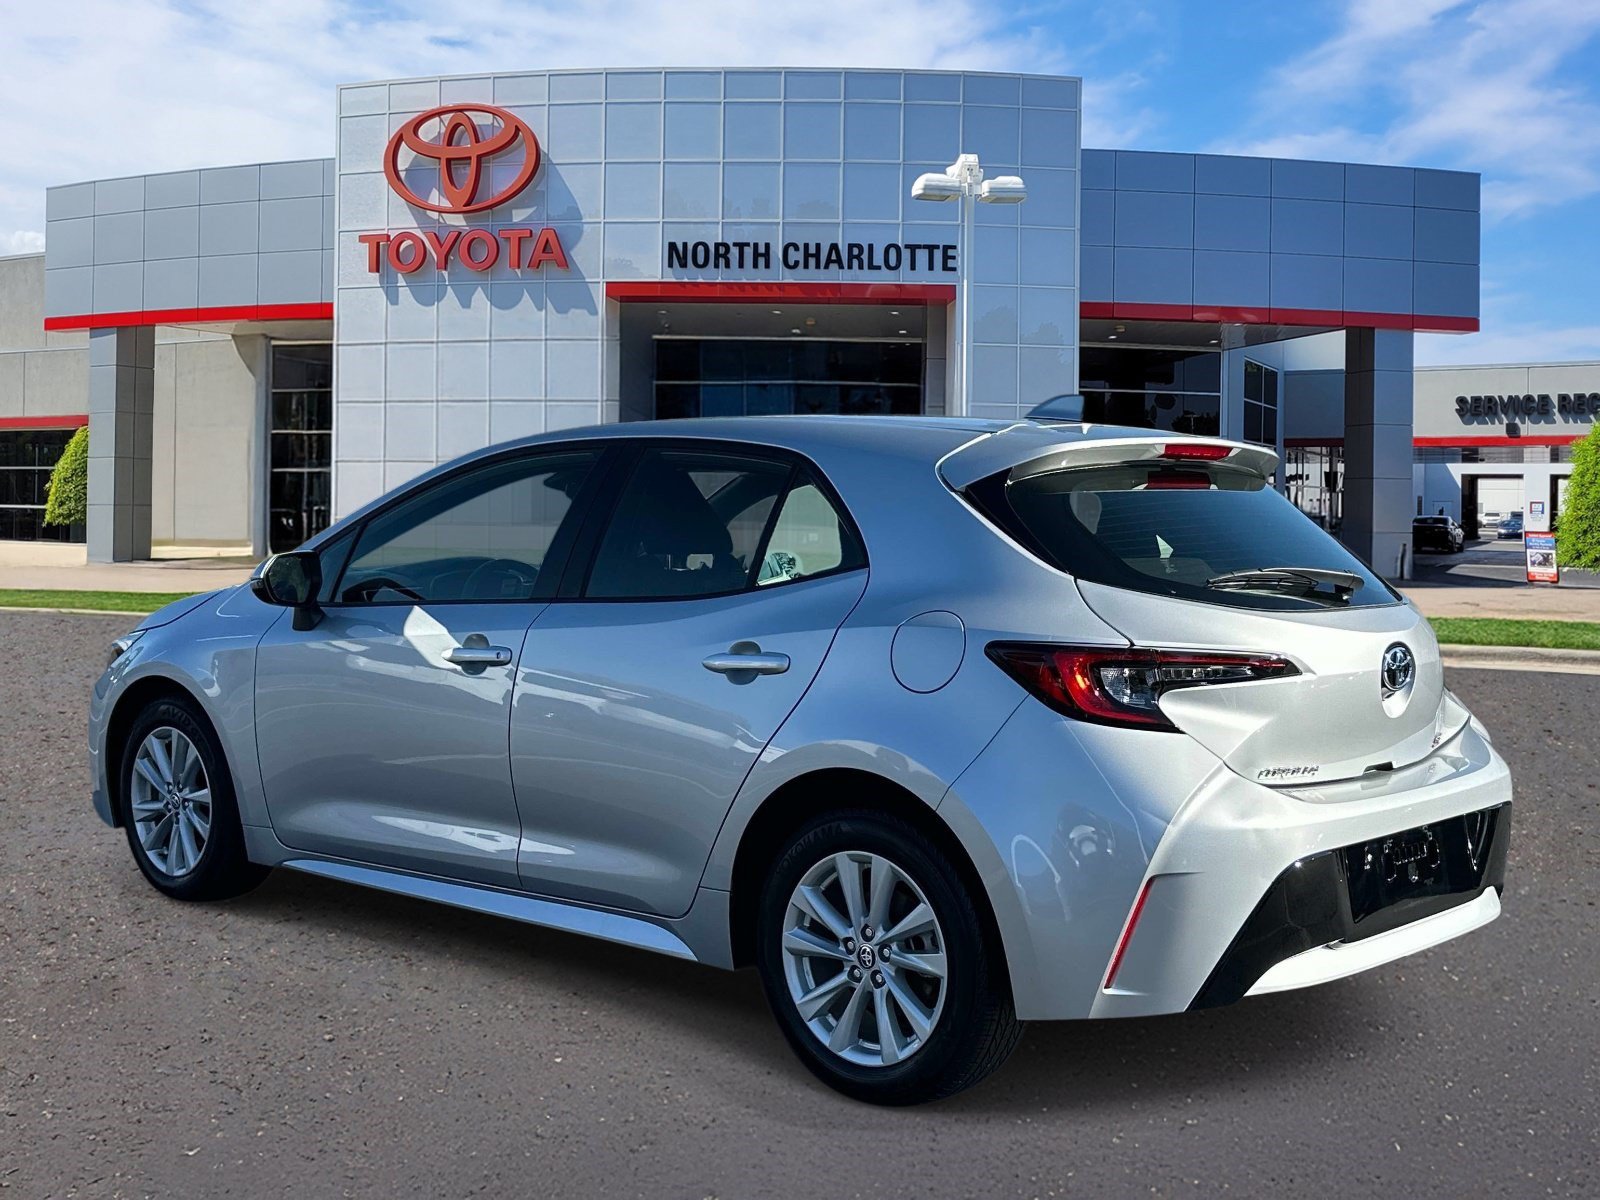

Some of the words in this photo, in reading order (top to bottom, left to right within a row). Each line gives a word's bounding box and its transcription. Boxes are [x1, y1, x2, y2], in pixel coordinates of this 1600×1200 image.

[359, 228, 569, 273] TOYOTA
[667, 241, 771, 270] NORTH
[782, 242, 958, 272] CHARLOTTE
[1455, 394, 1551, 416] SERVICE
